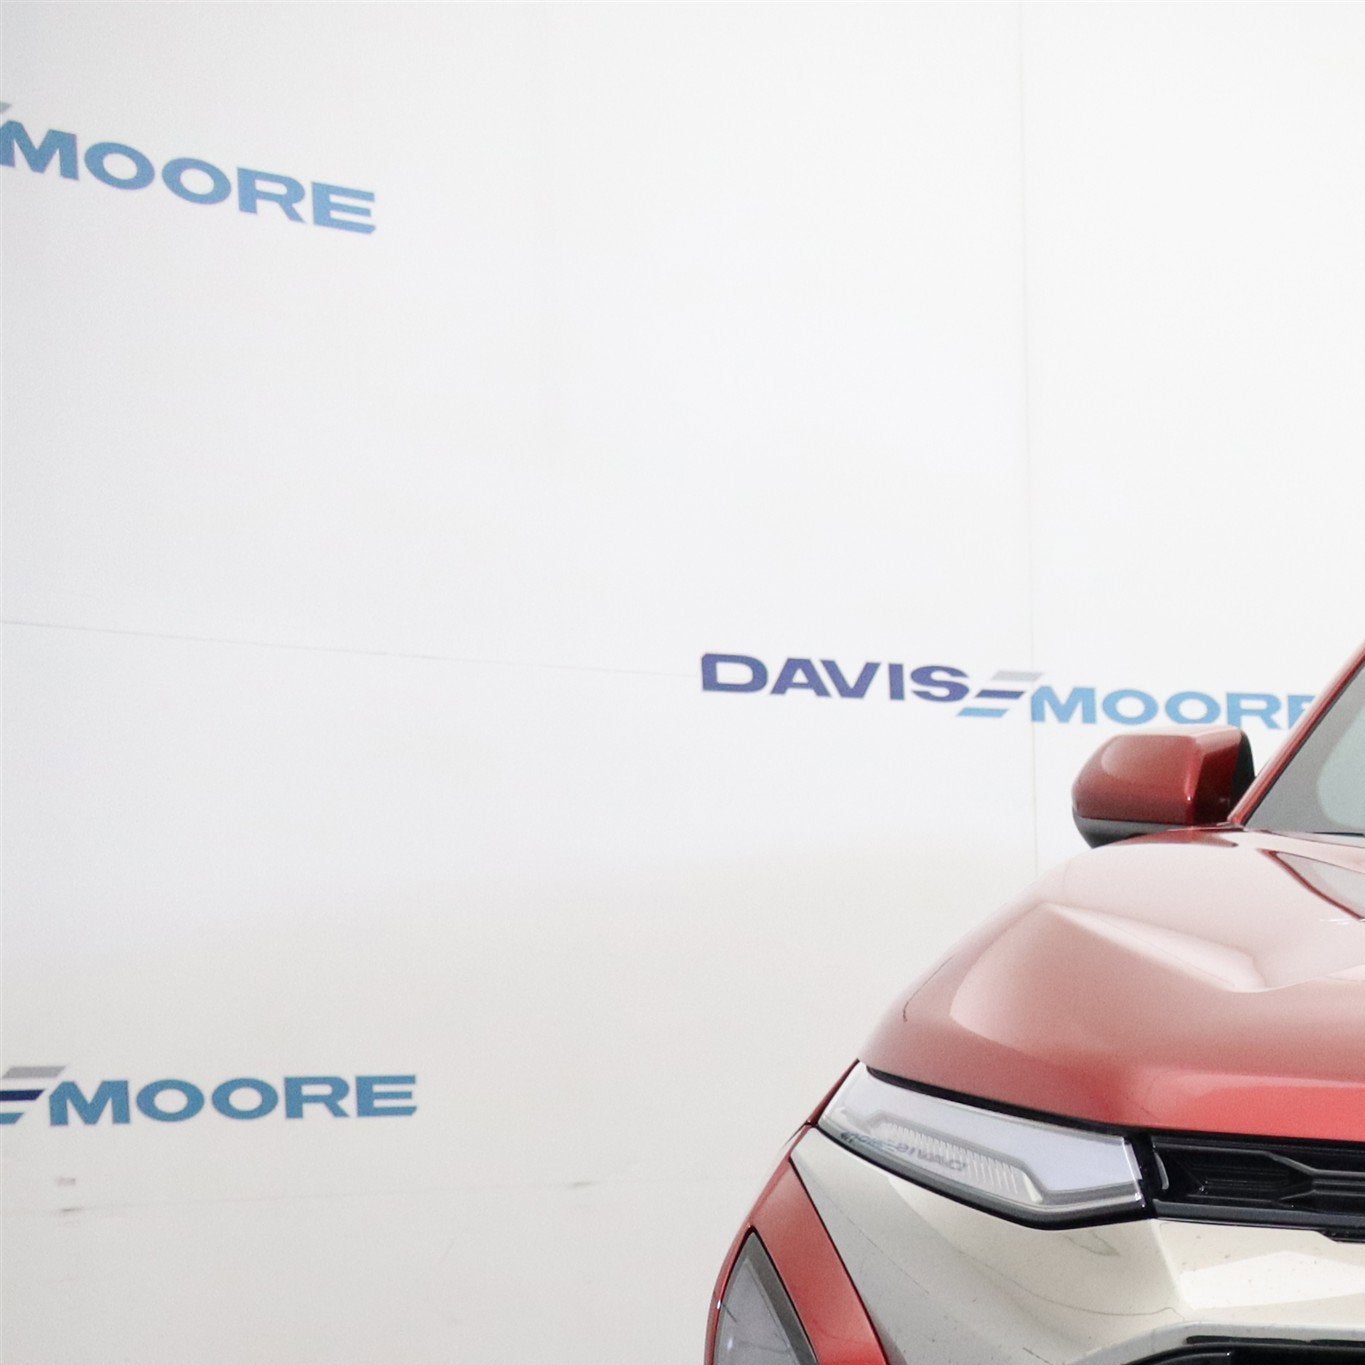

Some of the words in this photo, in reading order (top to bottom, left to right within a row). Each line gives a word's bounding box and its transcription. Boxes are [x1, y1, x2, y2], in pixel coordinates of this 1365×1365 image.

[0, 120, 377, 234] MOORE
[701, 654, 970, 701] DAVIS
[48, 1075, 417, 1126] MOORE
